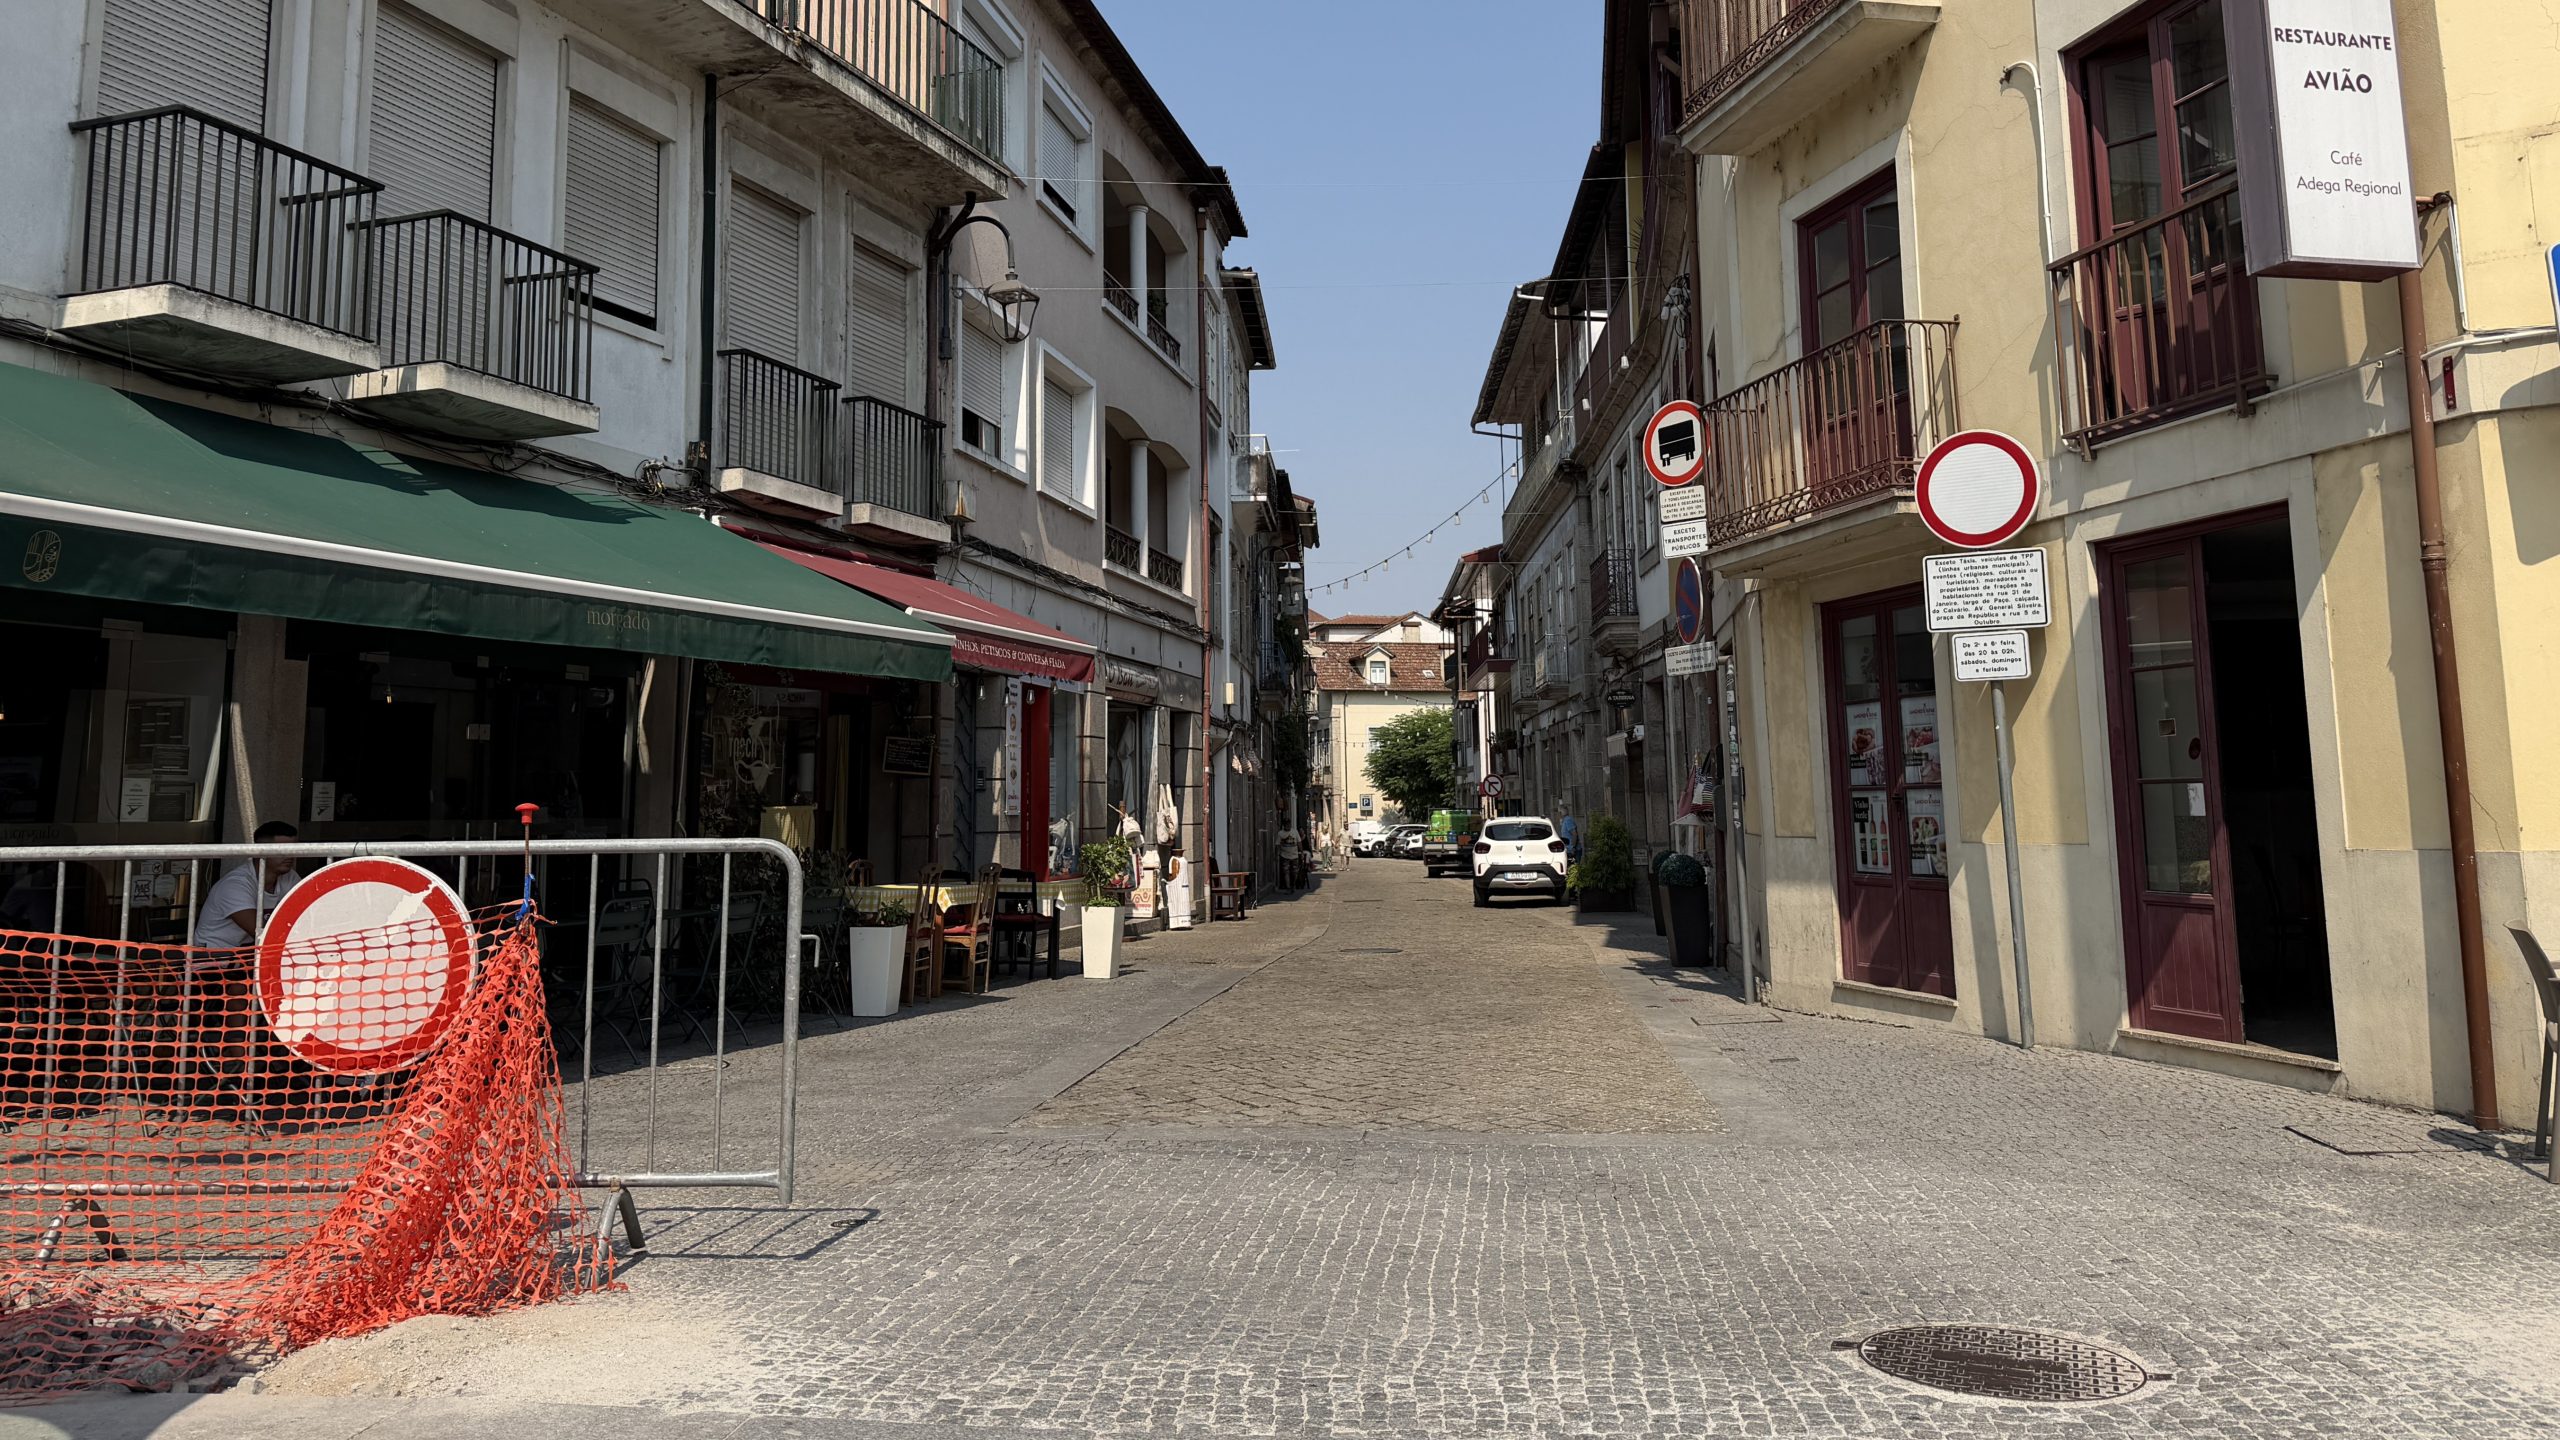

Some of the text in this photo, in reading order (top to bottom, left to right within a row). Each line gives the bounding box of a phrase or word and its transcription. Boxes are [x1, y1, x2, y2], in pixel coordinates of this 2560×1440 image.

[2274, 27, 2392, 50] RESTAURANTE
[2304, 68, 2372, 93] AVIÃO
[2330, 150, 2363, 165] Café
[2296, 176, 2402, 196] Adega Regional
[1665, 534, 1706, 544] TRANSPORTES
[1672, 543, 1700, 551] PÚBLICOS
[1940, 585, 1979, 593] proprietários
[1943, 592, 1982, 600] habitacionais
[587, 609, 650, 633] morgado
[1968, 611, 1998, 619] República
[981, 644, 1012, 659] PETISCOS
[1018, 651, 1049, 665] CONVERSA
[1049, 658, 1066, 669] FIADA
